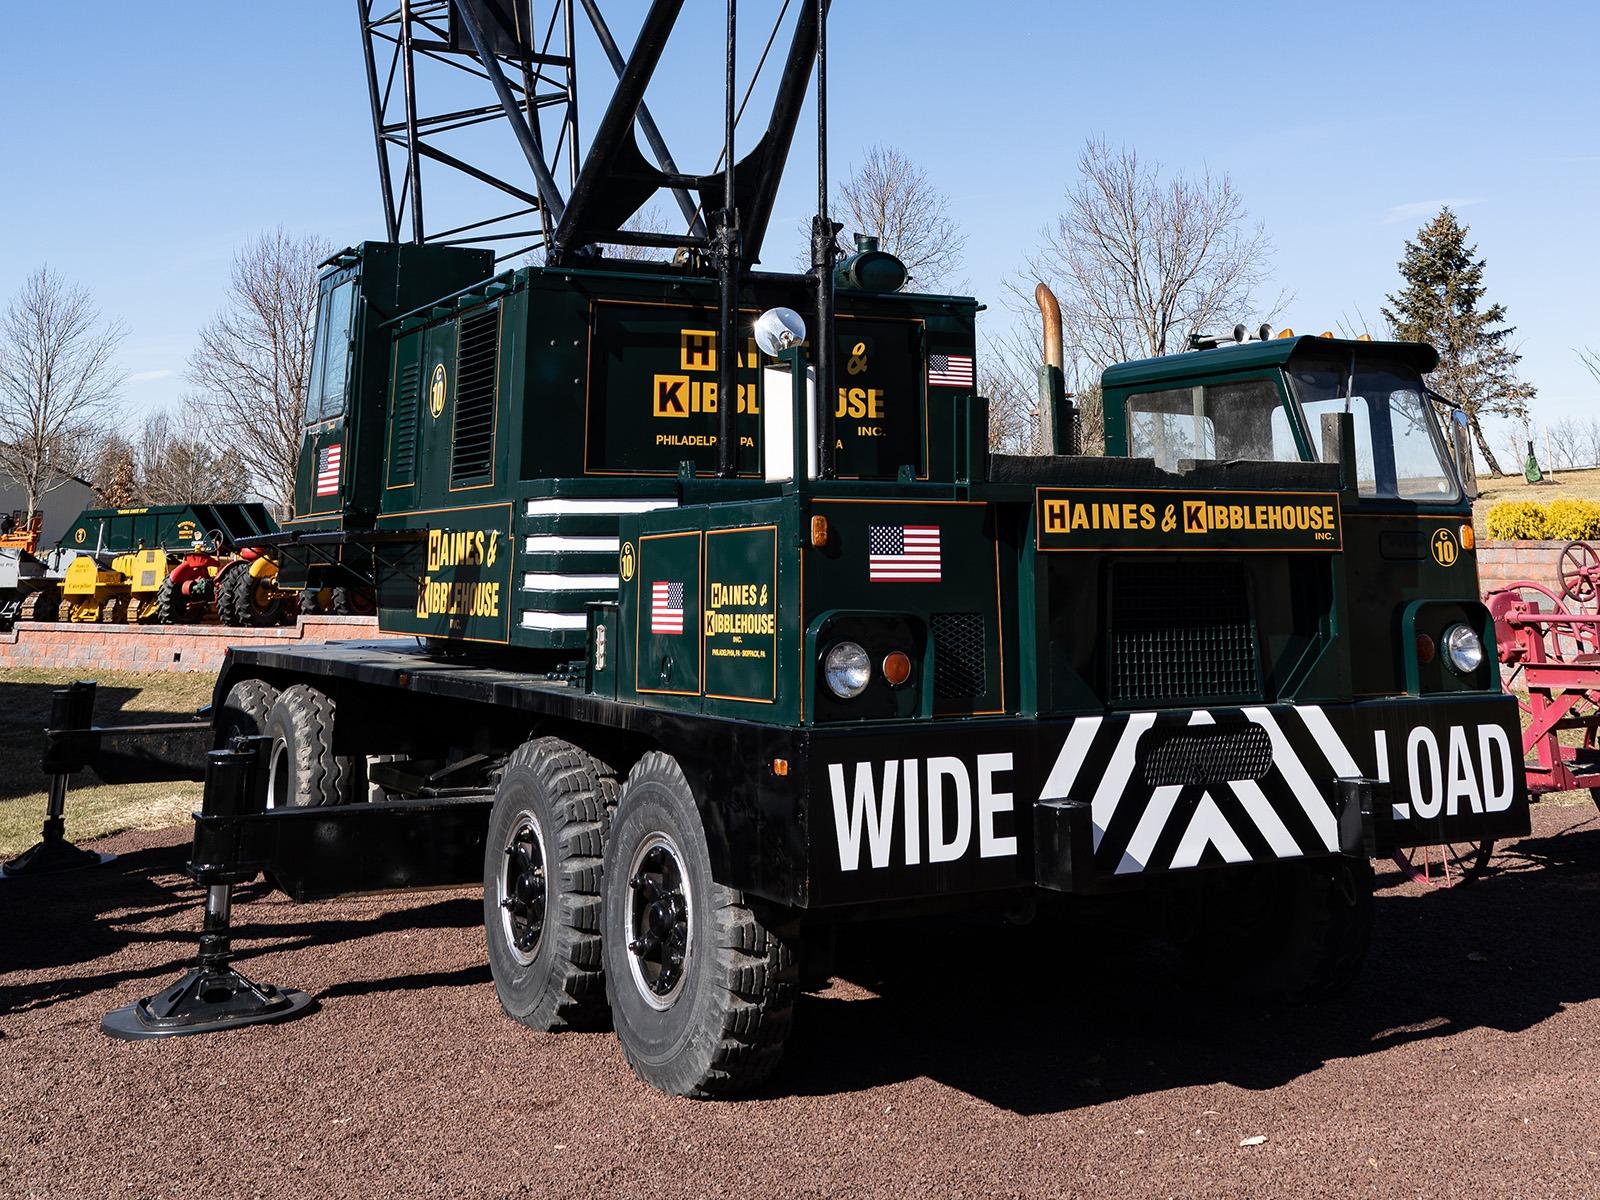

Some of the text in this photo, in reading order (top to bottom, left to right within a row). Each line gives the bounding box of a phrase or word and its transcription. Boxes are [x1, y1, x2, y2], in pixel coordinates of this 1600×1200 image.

[847, 342, 868, 376] &
[433, 380, 444, 413] 10
[857, 426, 887, 437] INC.
[1044, 499, 1335, 534] HAINES & KIBBLEHOUSE
[1314, 532, 1335, 541] INC.
[1440, 531, 1448, 541] C
[427, 529, 500, 571] HAINES &
[625, 544, 630, 555] C
[1435, 540, 1455, 563] 10
[622, 554, 633, 578] 10
[416, 576, 500, 619] KIBBLEHOUSE
[711, 583, 768, 608] HAINES &
[705, 610, 774, 636] KIBBLEHOUSE
[828, 724, 1514, 872] WIDE LOAD
